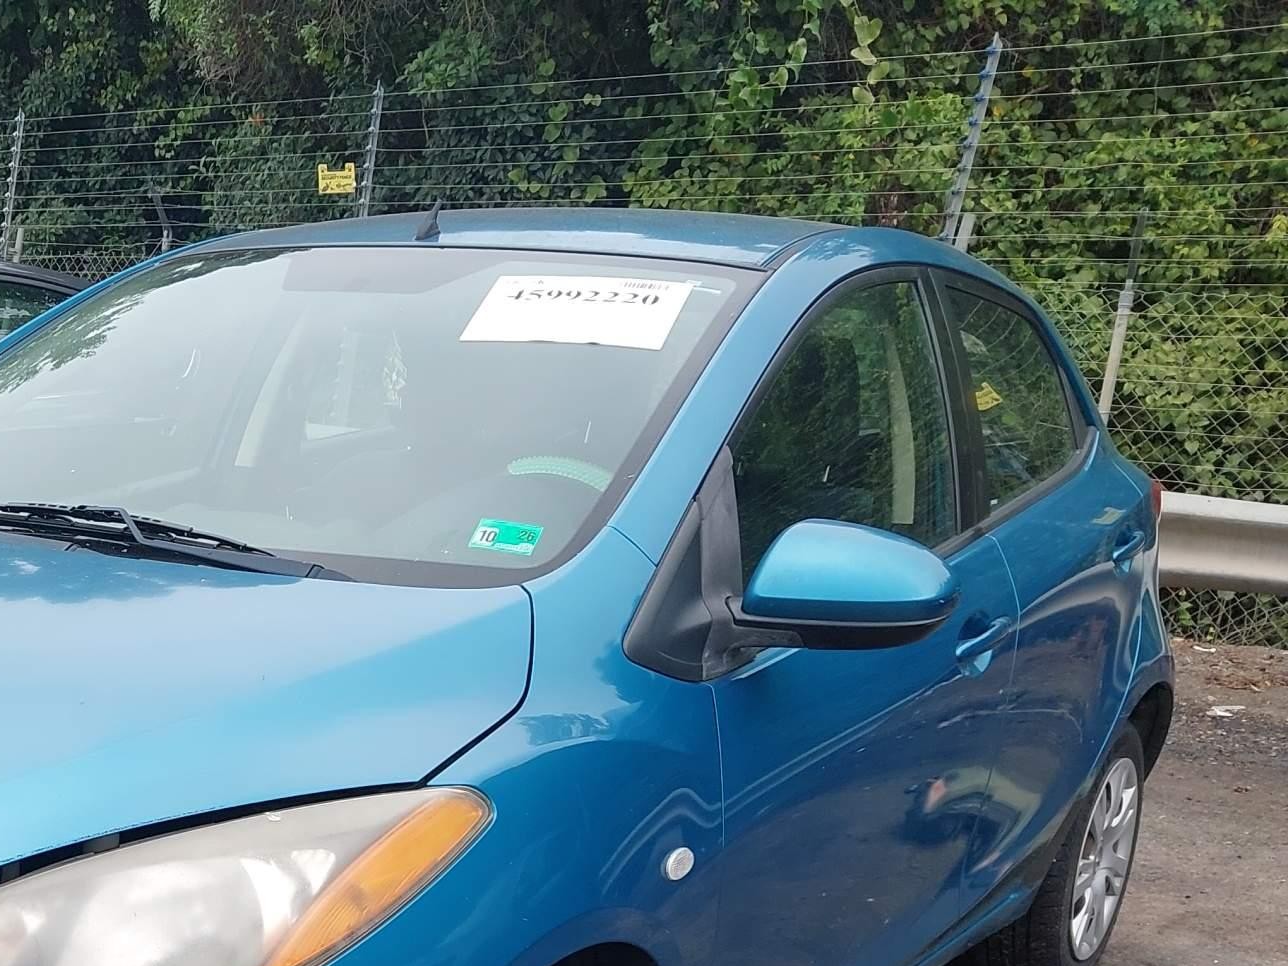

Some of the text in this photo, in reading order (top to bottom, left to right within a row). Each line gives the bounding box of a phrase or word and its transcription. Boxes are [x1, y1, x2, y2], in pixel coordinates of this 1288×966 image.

[507, 289, 660, 305] 45992220
[479, 529, 537, 543] 10 26
